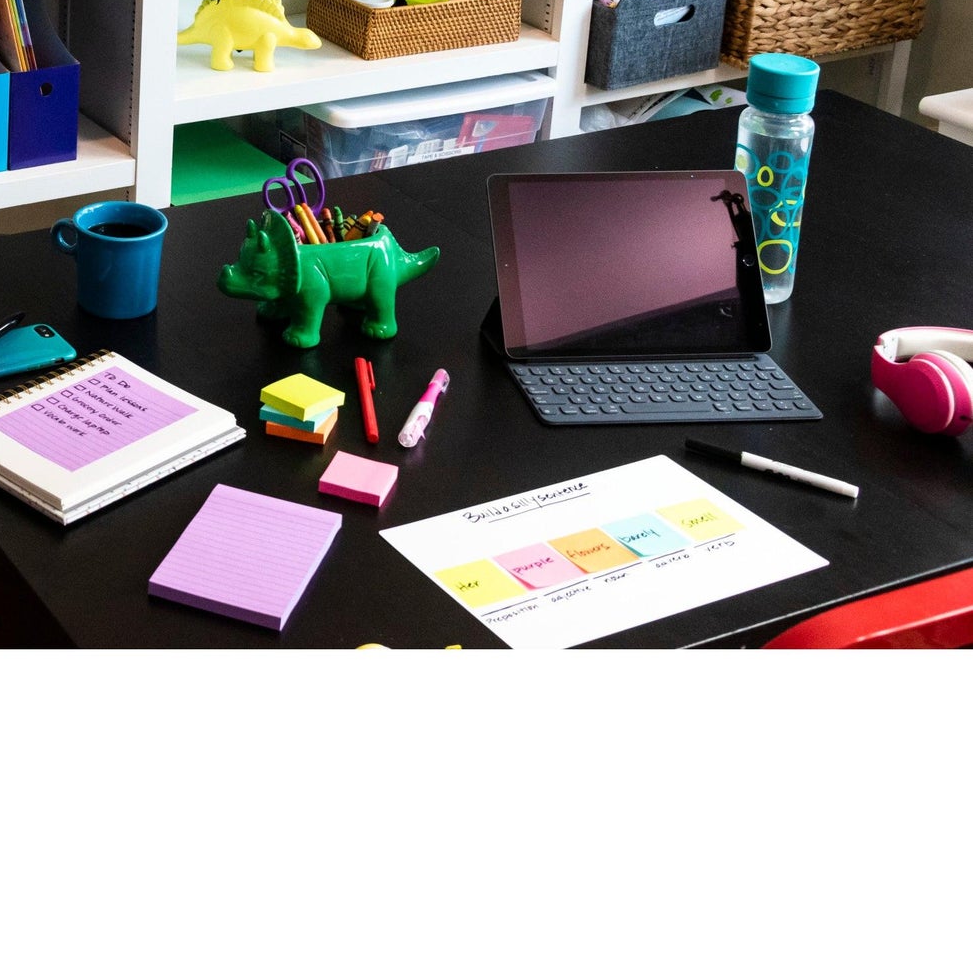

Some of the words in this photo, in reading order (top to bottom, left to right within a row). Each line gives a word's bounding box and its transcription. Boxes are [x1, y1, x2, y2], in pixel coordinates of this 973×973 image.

[100, 384, 118, 397] Plan
[85, 390, 115, 408] Nature
[456, 580, 480, 593] Her
